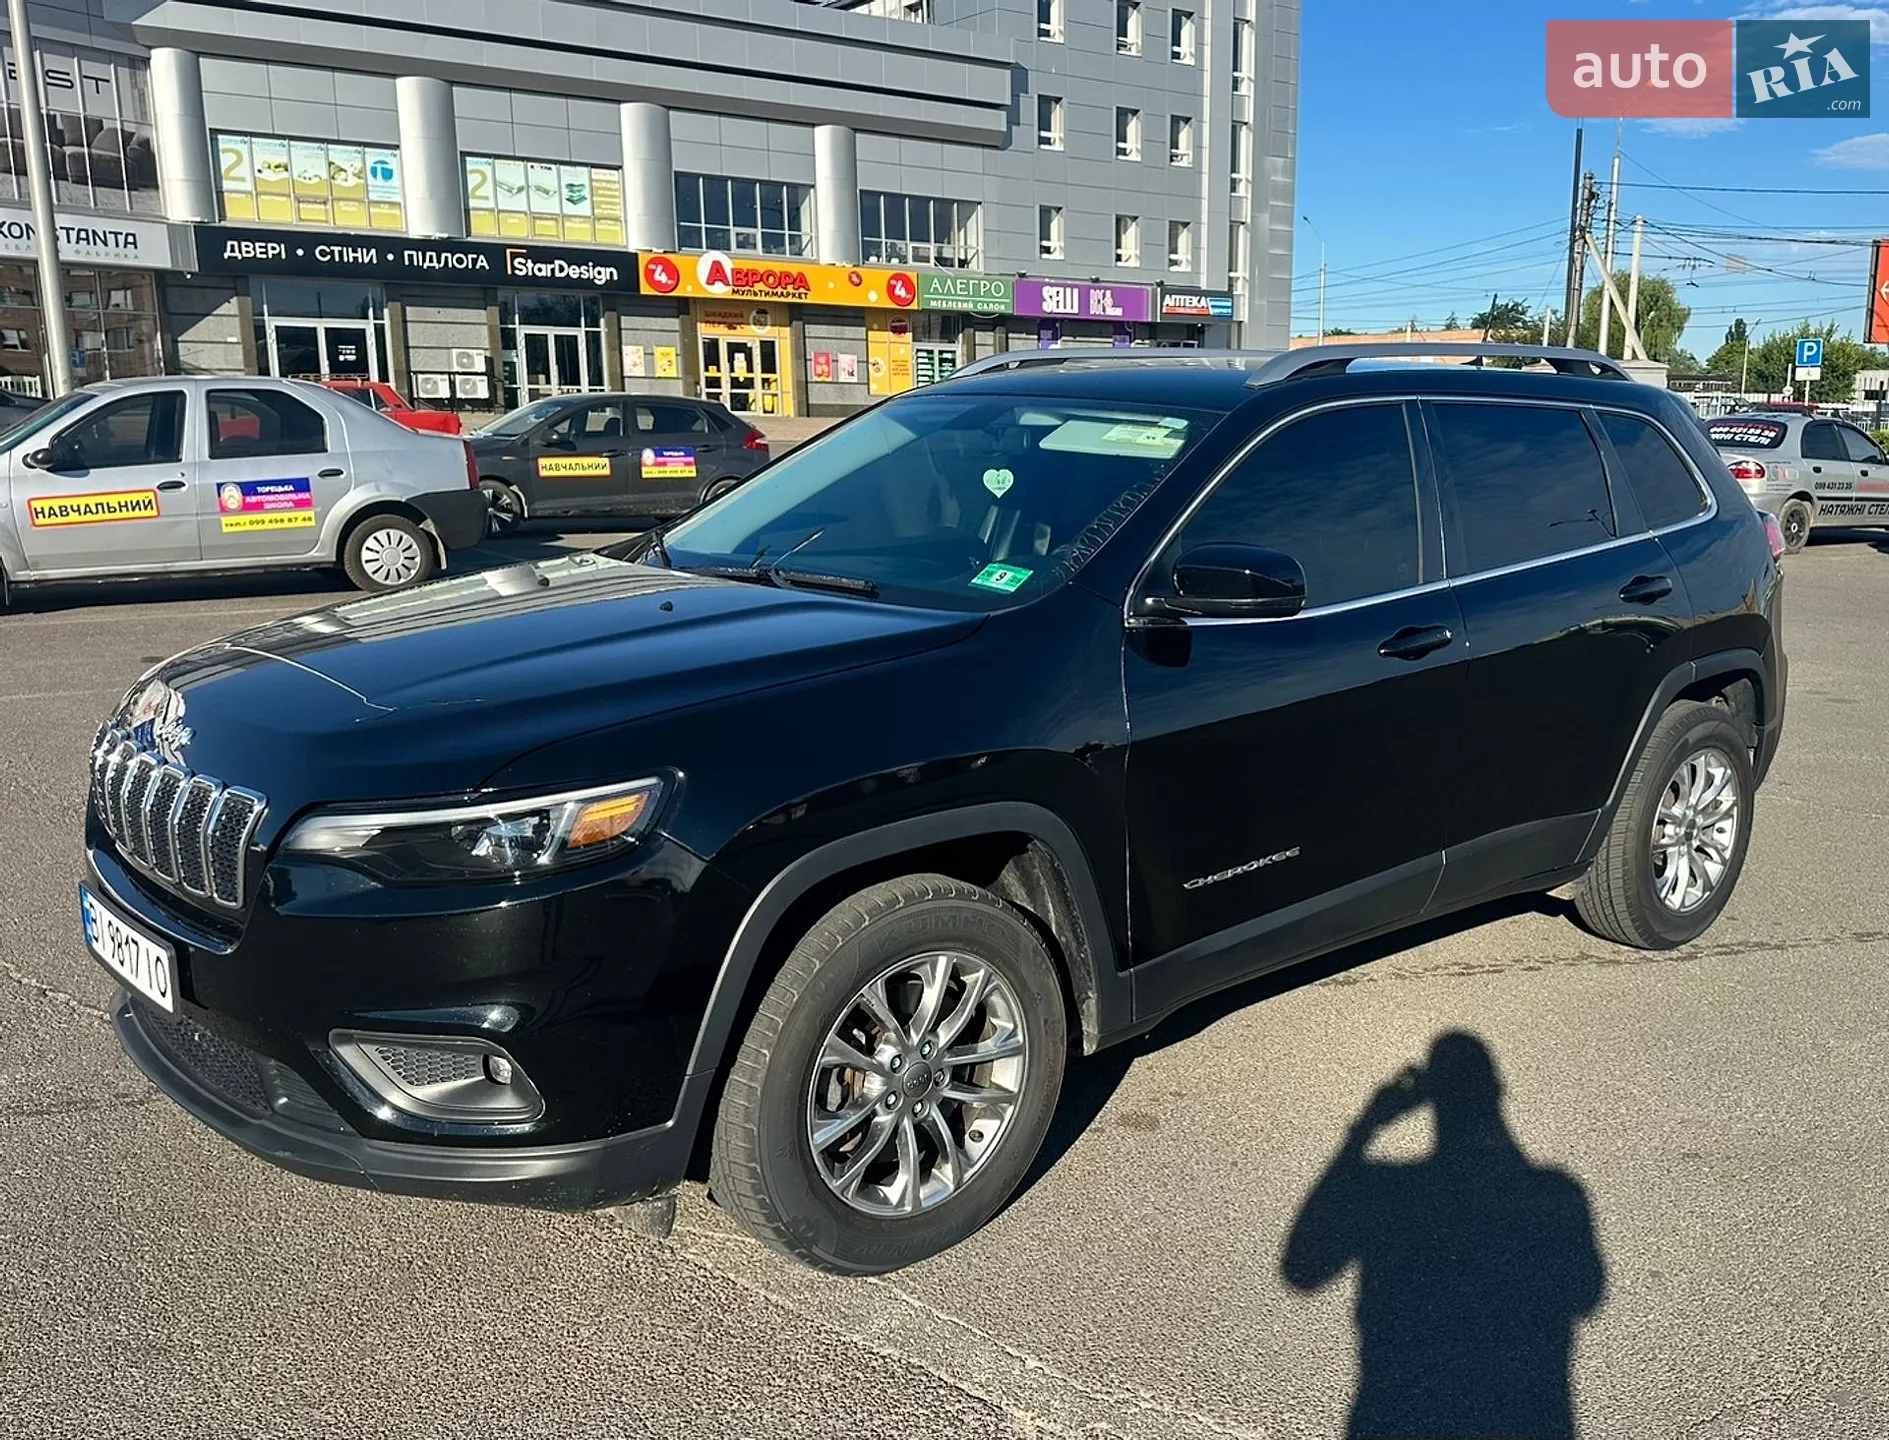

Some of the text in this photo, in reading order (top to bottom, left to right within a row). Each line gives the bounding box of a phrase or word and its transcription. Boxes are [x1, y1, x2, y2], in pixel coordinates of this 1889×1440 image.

[221, 147, 246, 182] 2
[468, 168, 489, 201] 2
[0, 219, 139, 250] KONTANTA
[223, 240, 490, 270] ДВЕРІ СТІНИ ПІДЛОГА
[513, 257, 618, 286] StarDesign
[653, 264, 669, 285] 4
[705, 259, 812, 292] АВРОРА
[731, 287, 809, 300] МУЛЬТИМАРКЕТ
[929, 277, 1005, 297] АЛЕГРО
[1042, 285, 1079, 314] SELLI
[1163, 294, 1208, 308] АПТЕКА
[976, 302, 1006, 311] САЛОН
[1803, 341, 1818, 363] P
[33, 495, 154, 520] НАВЧАЛЬНИЙ
[1818, 503, 1866, 516] НАТЯЖНІ
[1182, 846, 1301, 890] CHEROKEE
[107, 920, 139, 979] 9817
